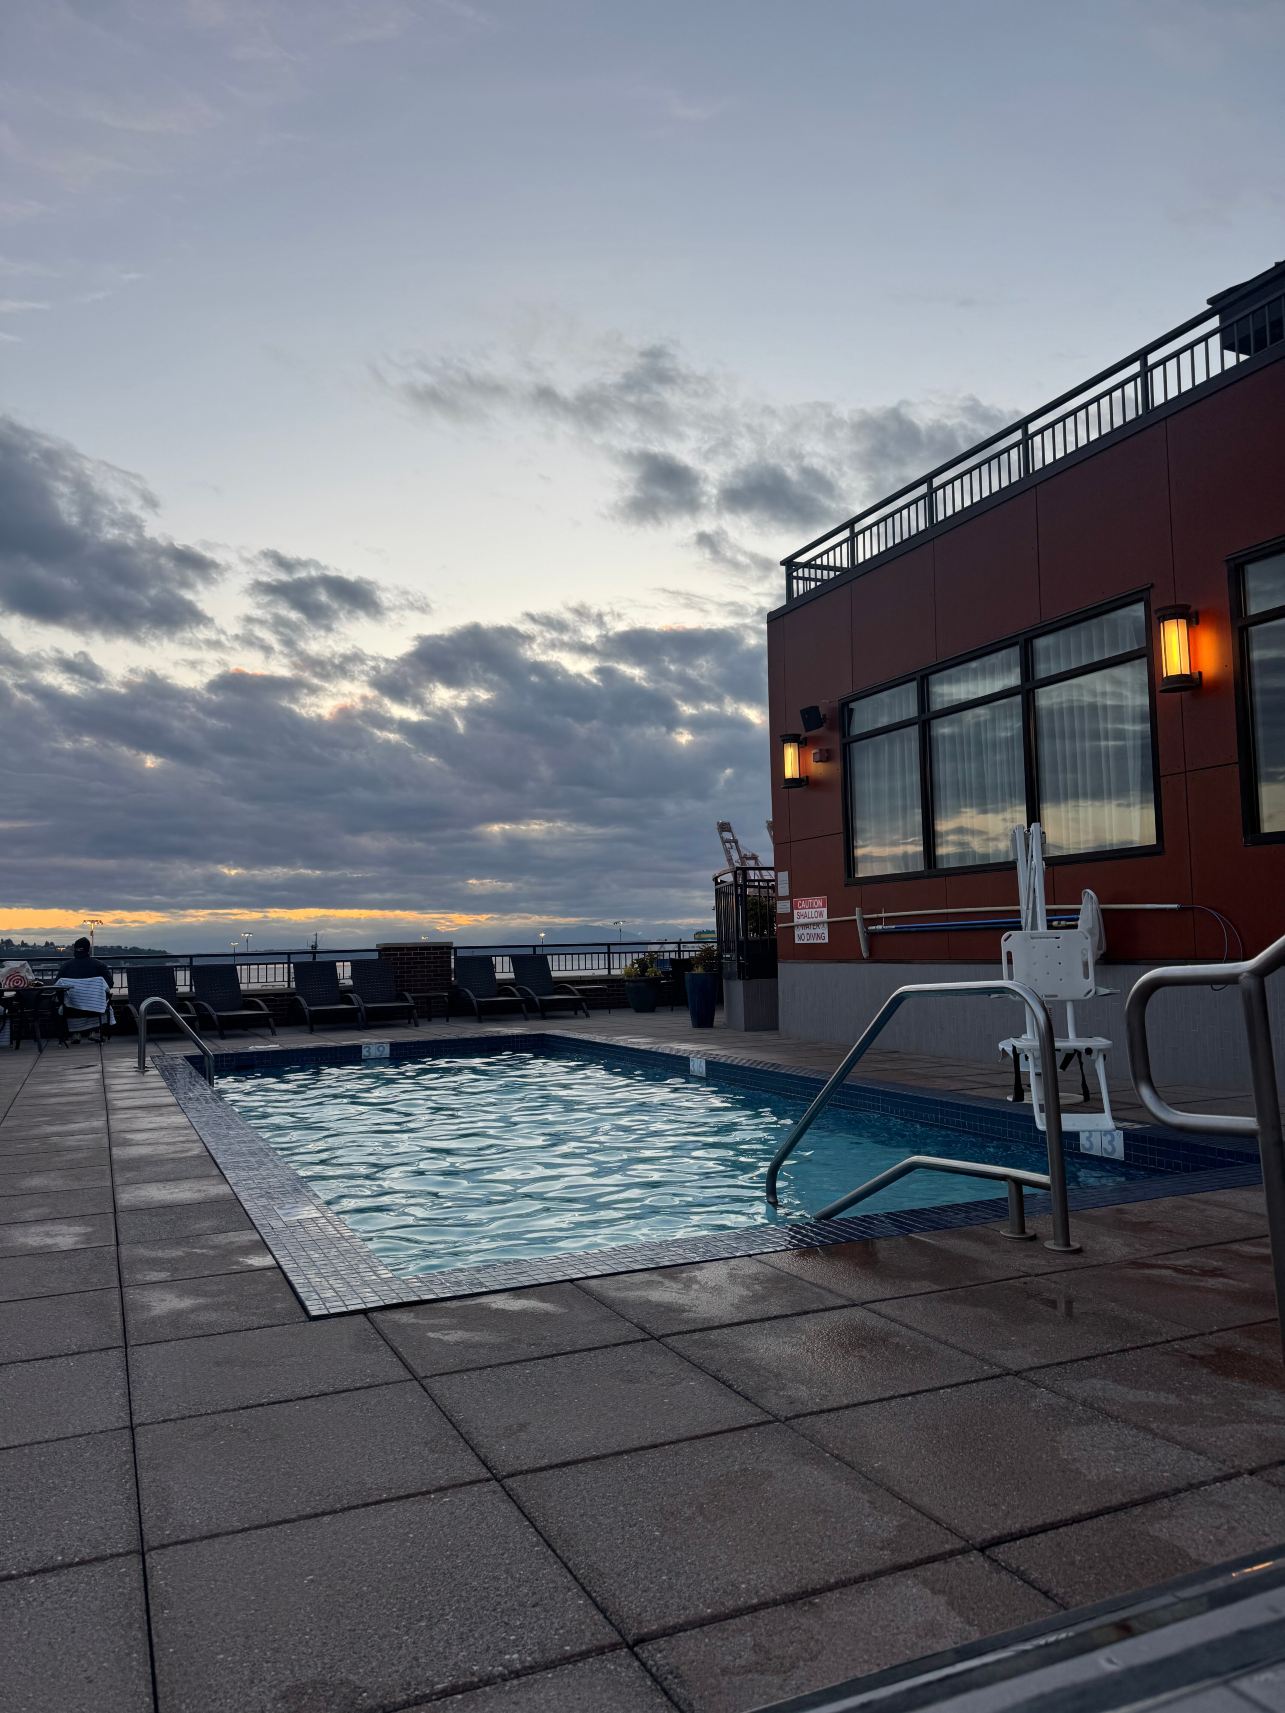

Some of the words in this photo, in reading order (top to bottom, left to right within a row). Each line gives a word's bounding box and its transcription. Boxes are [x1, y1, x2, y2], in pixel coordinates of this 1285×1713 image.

[797, 899, 823, 909] CAUTION
[796, 910, 825, 920] SHALLOW
[797, 932, 806, 942] NO
[806, 932, 826, 942] DIVING
